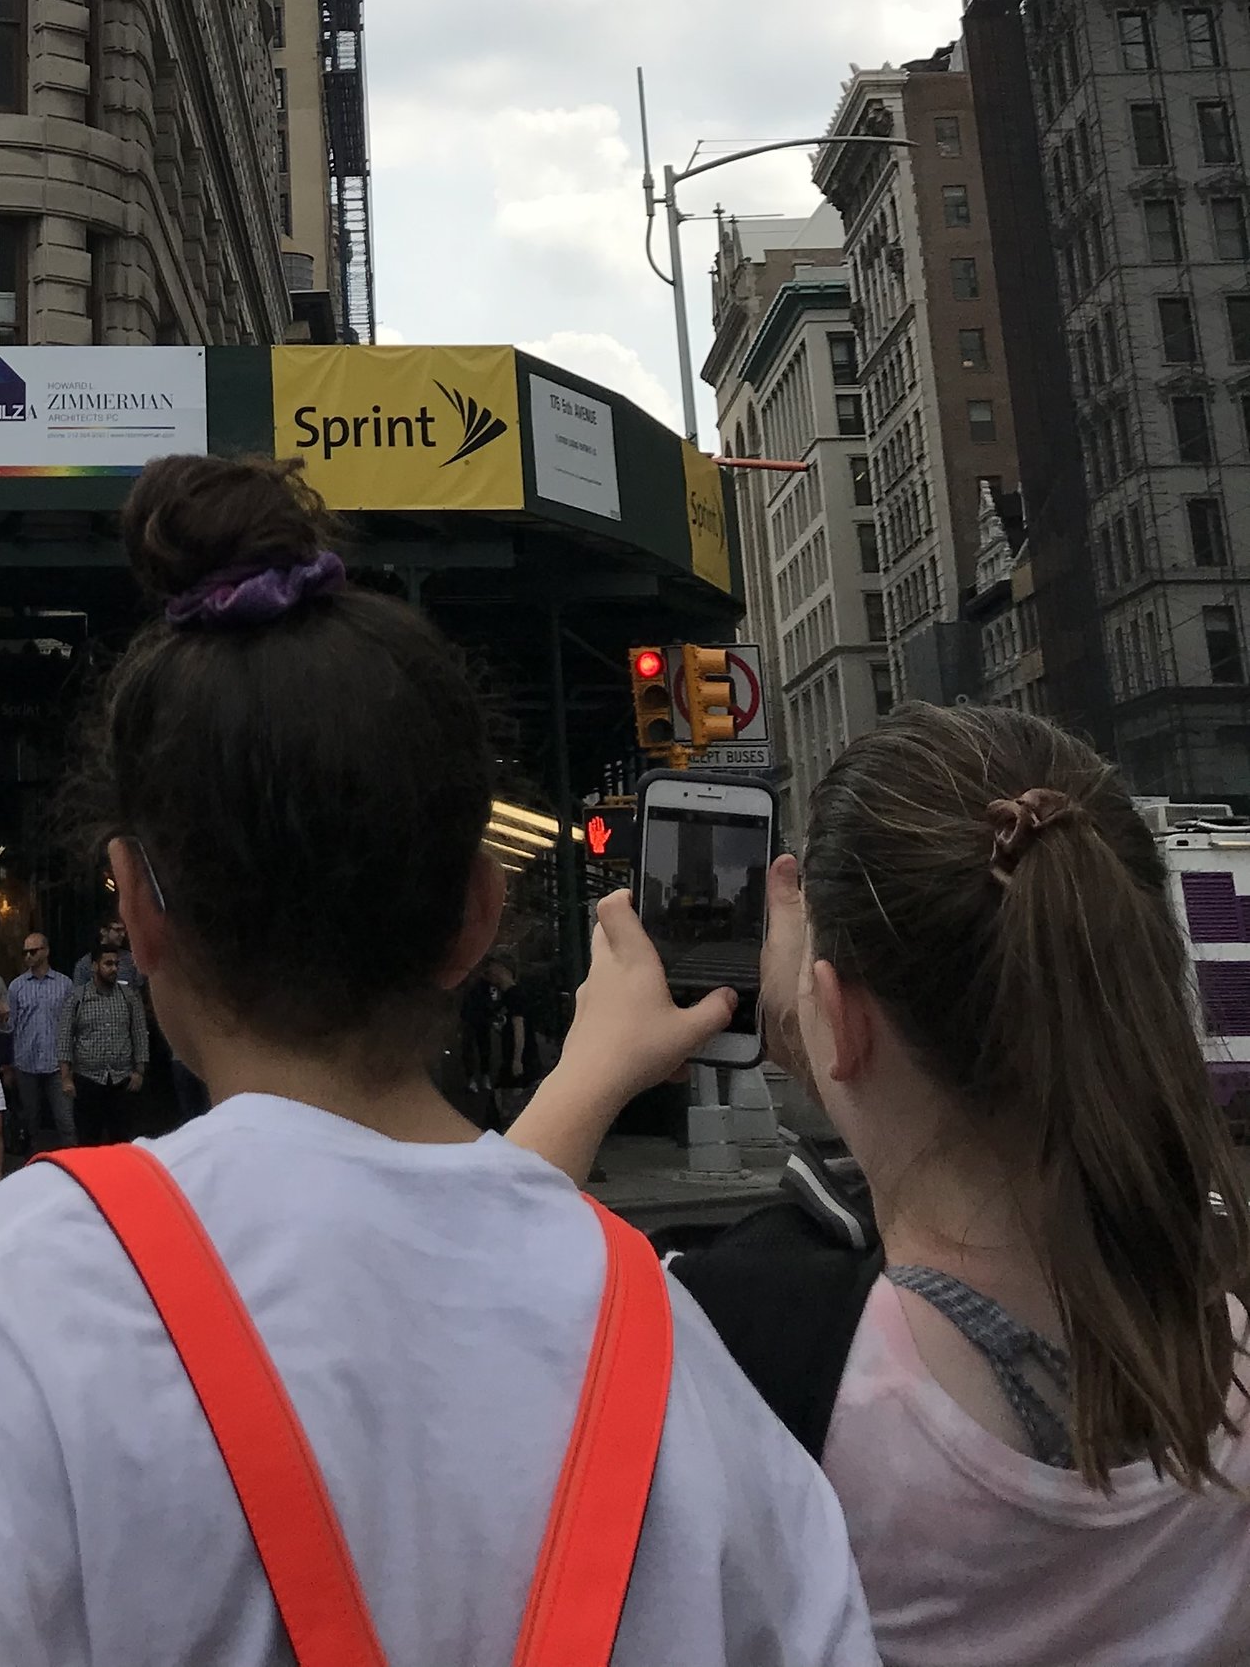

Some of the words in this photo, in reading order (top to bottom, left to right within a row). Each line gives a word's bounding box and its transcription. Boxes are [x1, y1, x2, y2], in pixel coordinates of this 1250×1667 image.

[48, 382, 88, 390] HOWARD
[47, 394, 174, 410] ZIMMERMAN
[48, 414, 104, 422] ARCHITECTS
[574, 403, 597, 425] AVENUE
[294, 405, 436, 460] Sprint
[691, 491, 719, 538] Sprint
[726, 750, 765, 763] BUSES
